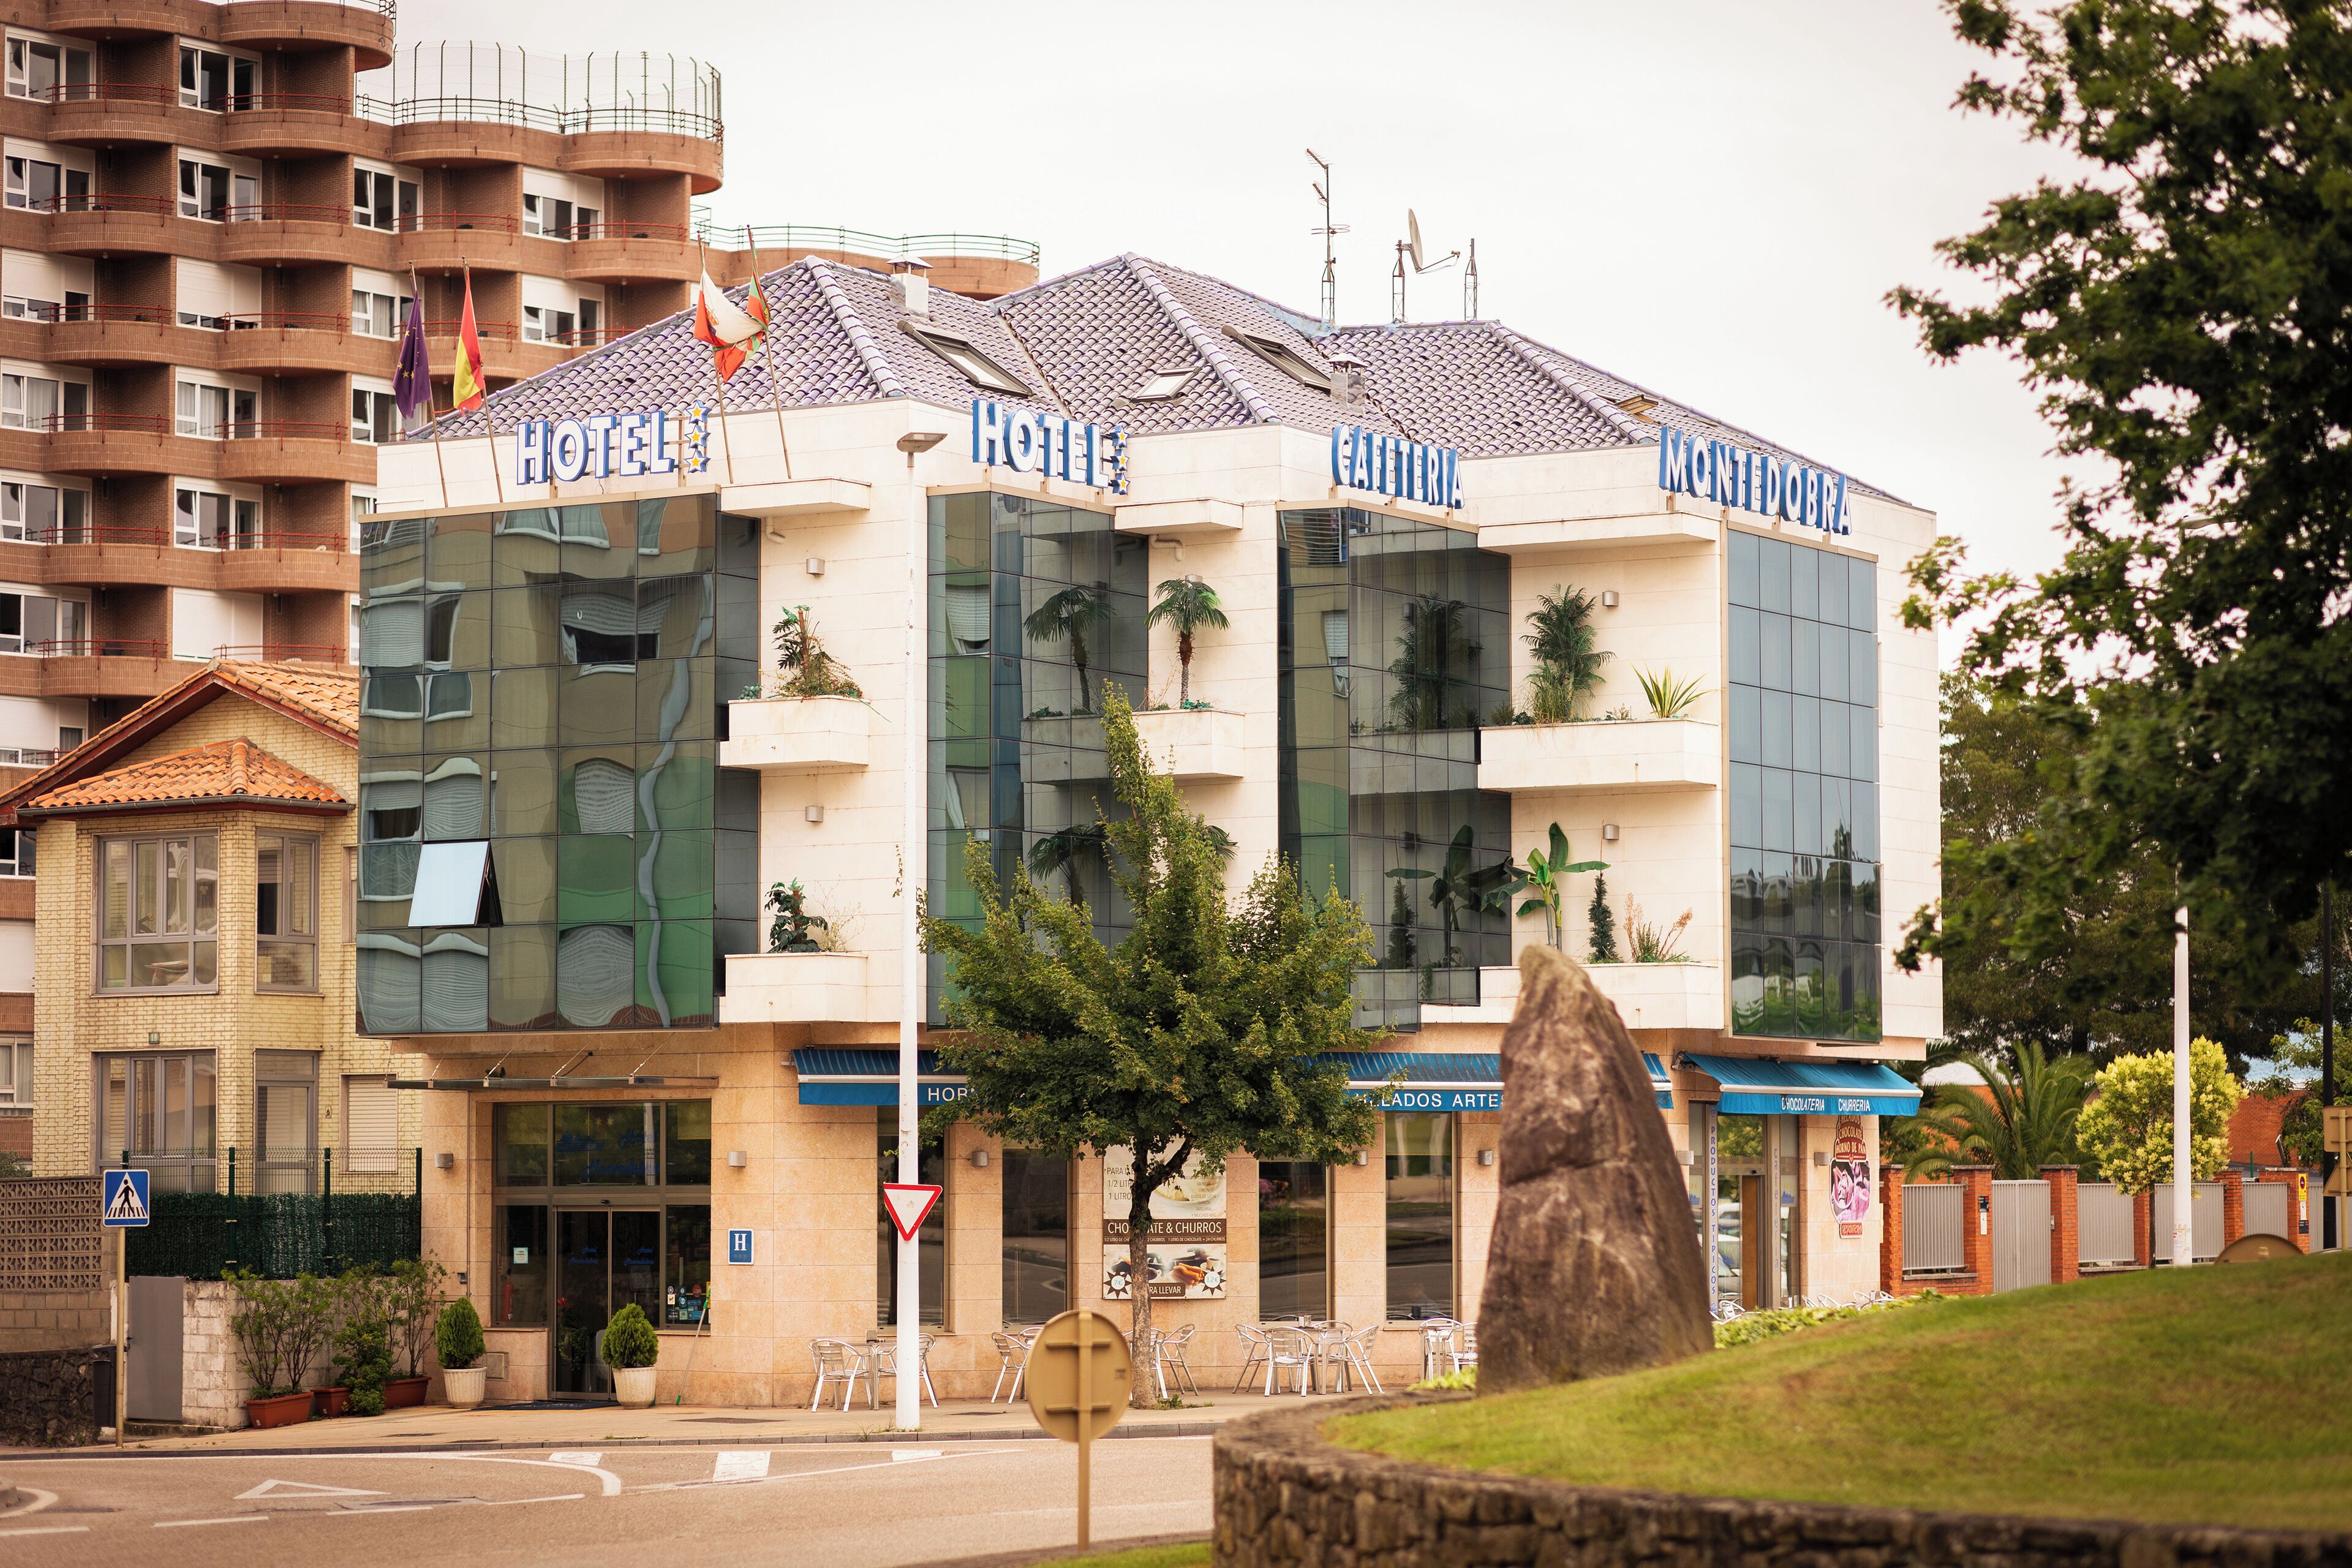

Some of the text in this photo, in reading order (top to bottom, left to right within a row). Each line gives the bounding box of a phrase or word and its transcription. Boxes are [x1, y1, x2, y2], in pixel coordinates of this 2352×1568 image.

[516, 410, 675, 485] HOTEL
[973, 399, 1109, 488] HOTEL
[1332, 423, 1465, 510] CAFETERIA
[1659, 425, 1853, 535] MONTEDOBRA
[928, 1087, 978, 1101] HOR
[1452, 1093, 1504, 1107] ARTE
[1782, 1097, 1871, 1112] CHOCOLATERIA CHURRERIA
[1839, 1126, 1863, 1140] CHOCOLATE
[1836, 1141, 1850, 1153] HORNO
[1852, 1142, 1857, 1153] DE
[1108, 1221, 1222, 1234] CHOATE & CHURROS
[734, 1233, 747, 1251] H
